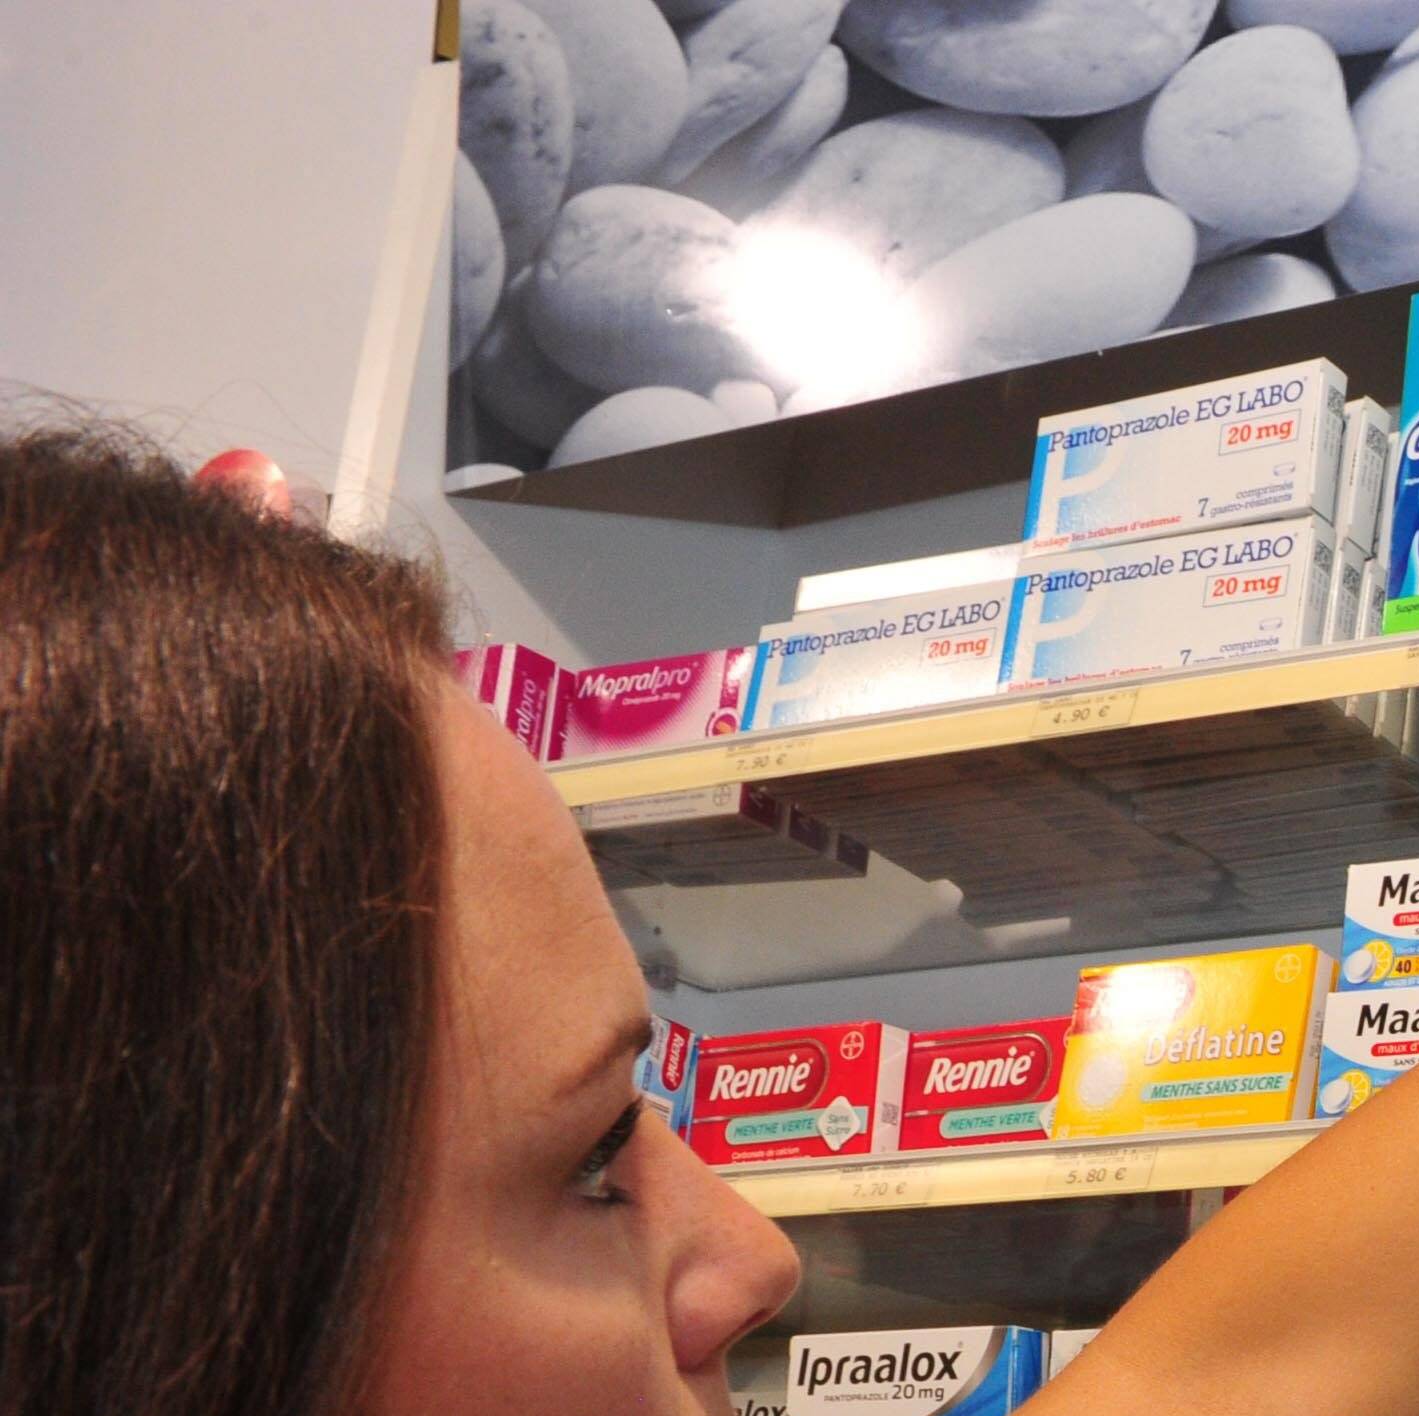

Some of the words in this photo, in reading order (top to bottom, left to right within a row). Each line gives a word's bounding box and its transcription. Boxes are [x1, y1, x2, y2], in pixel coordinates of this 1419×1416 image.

[1048, 402, 1190, 453] Pantoprazole
[1195, 393, 1231, 424] EG
[1235, 381, 1304, 416] LABO
[1227, 424, 1254, 444] 20
[1258, 418, 1294, 444] mg
[1236, 479, 1294, 501] comprimés
[766, 618, 896, 659] Pantoprazole
[901, 611, 934, 636] EG
[939, 599, 1001, 630] LABO
[578, 660, 692, 699] Mopralpro
[1143, 1024, 1285, 1067] Déflatine
[709, 1053, 812, 1101] Rennie
[1149, 1082, 1200, 1099] MENTHE
[1204, 1079, 1237, 1095] SANS
[1240, 1074, 1284, 1092] SUCRE
[797, 1343, 961, 1396] Ipraalox
[892, 1384, 915, 1400] 20
[918, 1385, 944, 1402] mg
